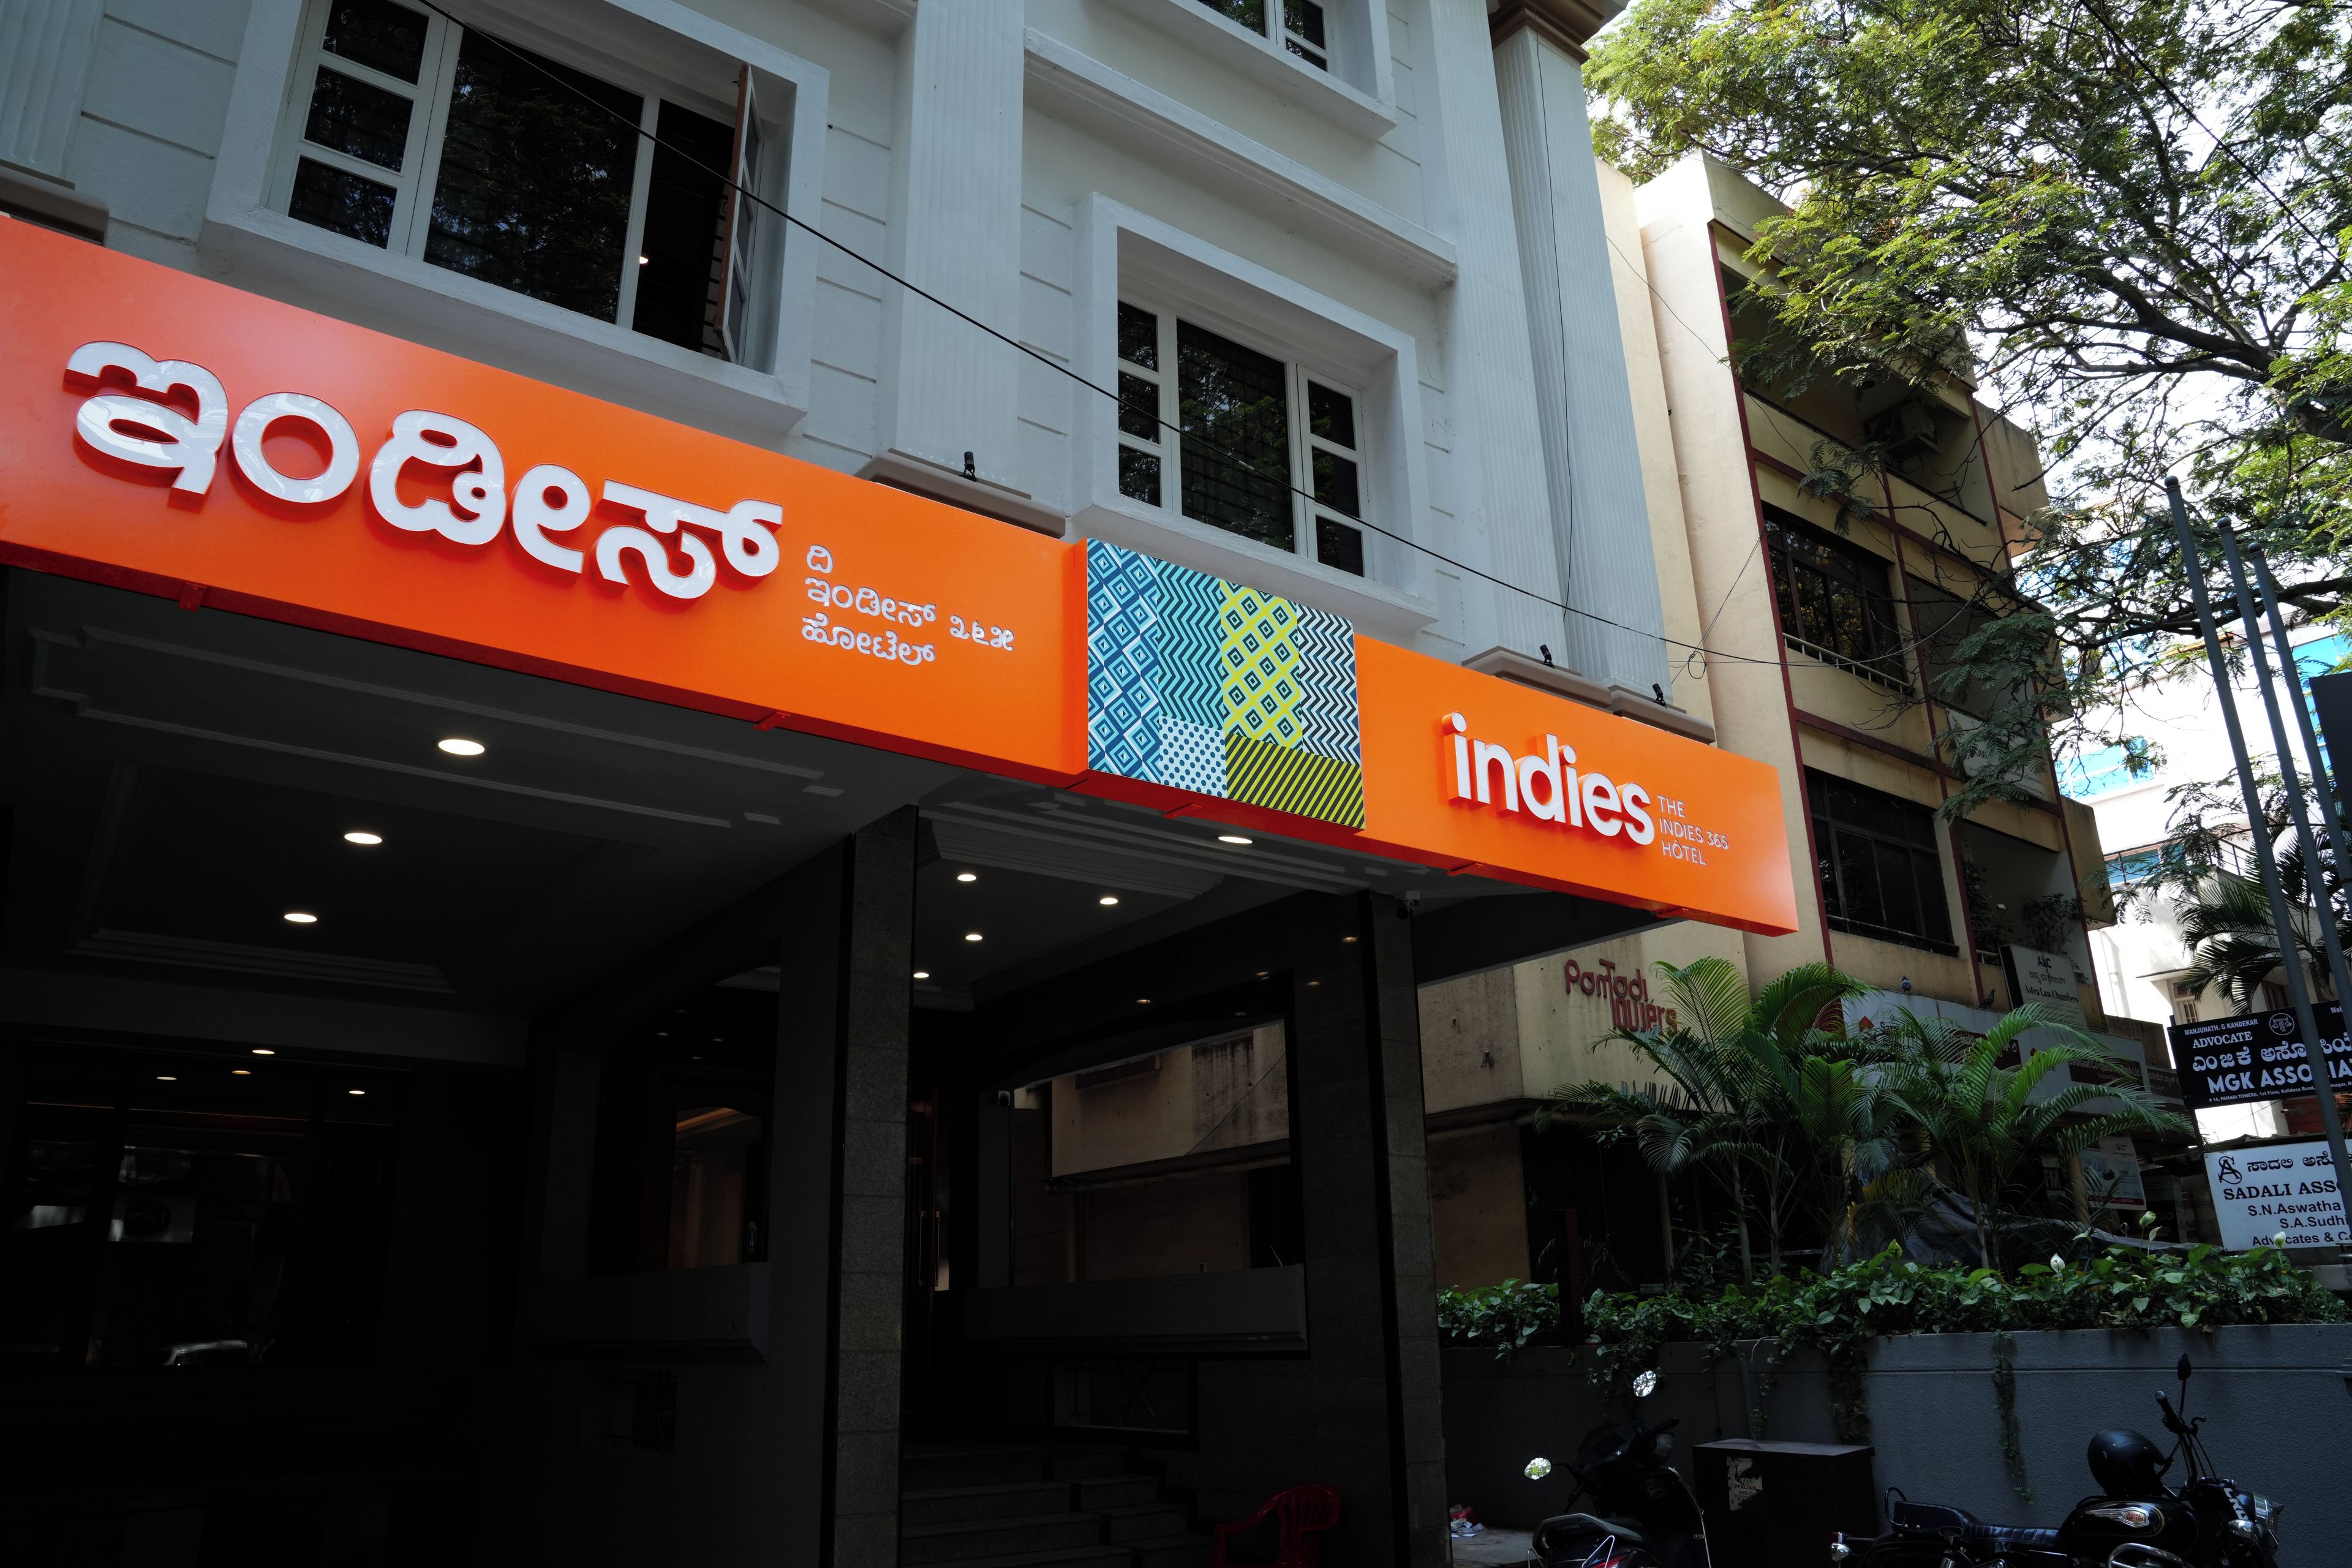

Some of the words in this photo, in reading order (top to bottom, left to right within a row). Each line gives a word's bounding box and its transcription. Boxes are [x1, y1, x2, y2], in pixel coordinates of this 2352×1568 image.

[64, 340, 783, 599] ಇಂಡೀಸ್
[806, 544, 833, 574] ದಿ
[805, 576, 937, 627] ಇಂಡೀಸ್
[802, 611, 937, 666] ಹೋಟೆಲ್
[1443, 711, 1655, 845] indies
[1657, 794, 1686, 818] THE
[1659, 817, 1705, 843] INDIES
[1706, 831, 1729, 850] 365
[2025, 985, 2040, 996] Astra
[2040, 987, 2051, 998] Law
[2051, 990, 2079, 1003] Chambers
[2226, 1019, 2259, 1029] KANDEKAR
[2193, 1031, 2253, 1049] ADVOCATE
[2207, 1071, 2255, 1094] MGK
[2247, 1158, 2293, 1172] ಸಾದಲಿ
[2223, 1183, 2292, 1200] SADALI
[2298, 1180, 2340, 1195] ASS
[2253, 1234, 2320, 1246] Advcates
[2324, 1232, 2334, 1243] &
